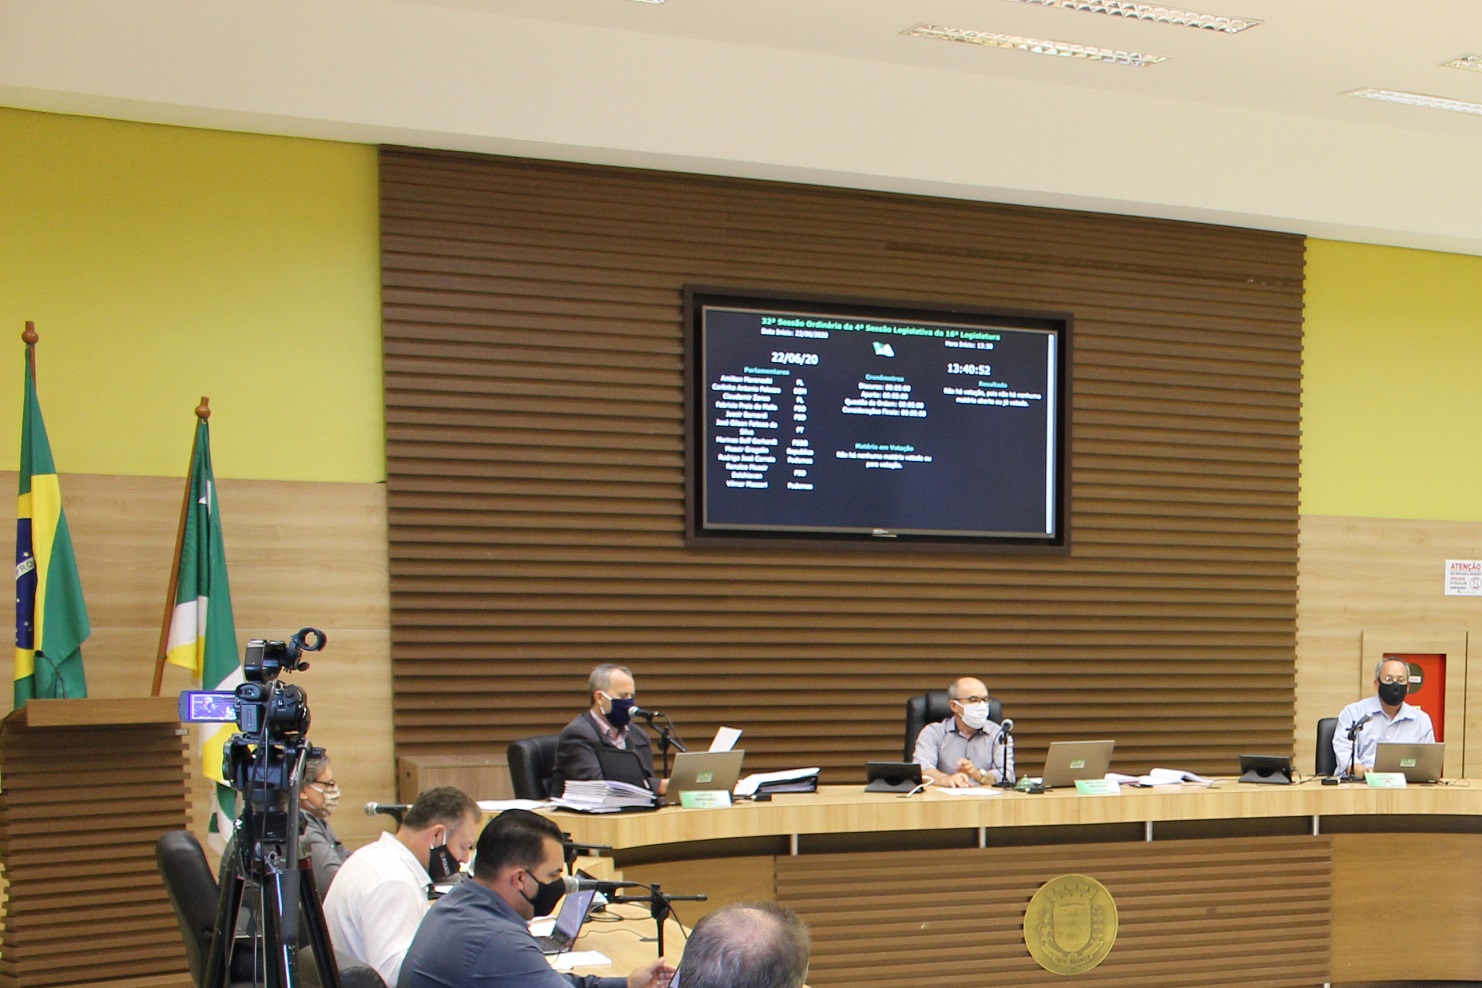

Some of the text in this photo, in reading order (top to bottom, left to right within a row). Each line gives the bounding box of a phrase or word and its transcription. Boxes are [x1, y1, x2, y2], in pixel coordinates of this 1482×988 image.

[778, 319, 805, 327] Sessão
[806, 321, 841, 329] Ordinária
[866, 325, 892, 333] Sessão
[893, 324, 933, 336] Legislativa
[961, 332, 1000, 340] Legislatura
[771, 352, 818, 365] 22/06/20
[744, 367, 789, 375] Parlamentares
[948, 364, 991, 375] 13:40:52
[1451, 562, 1482, 572] ATENÇÃO
